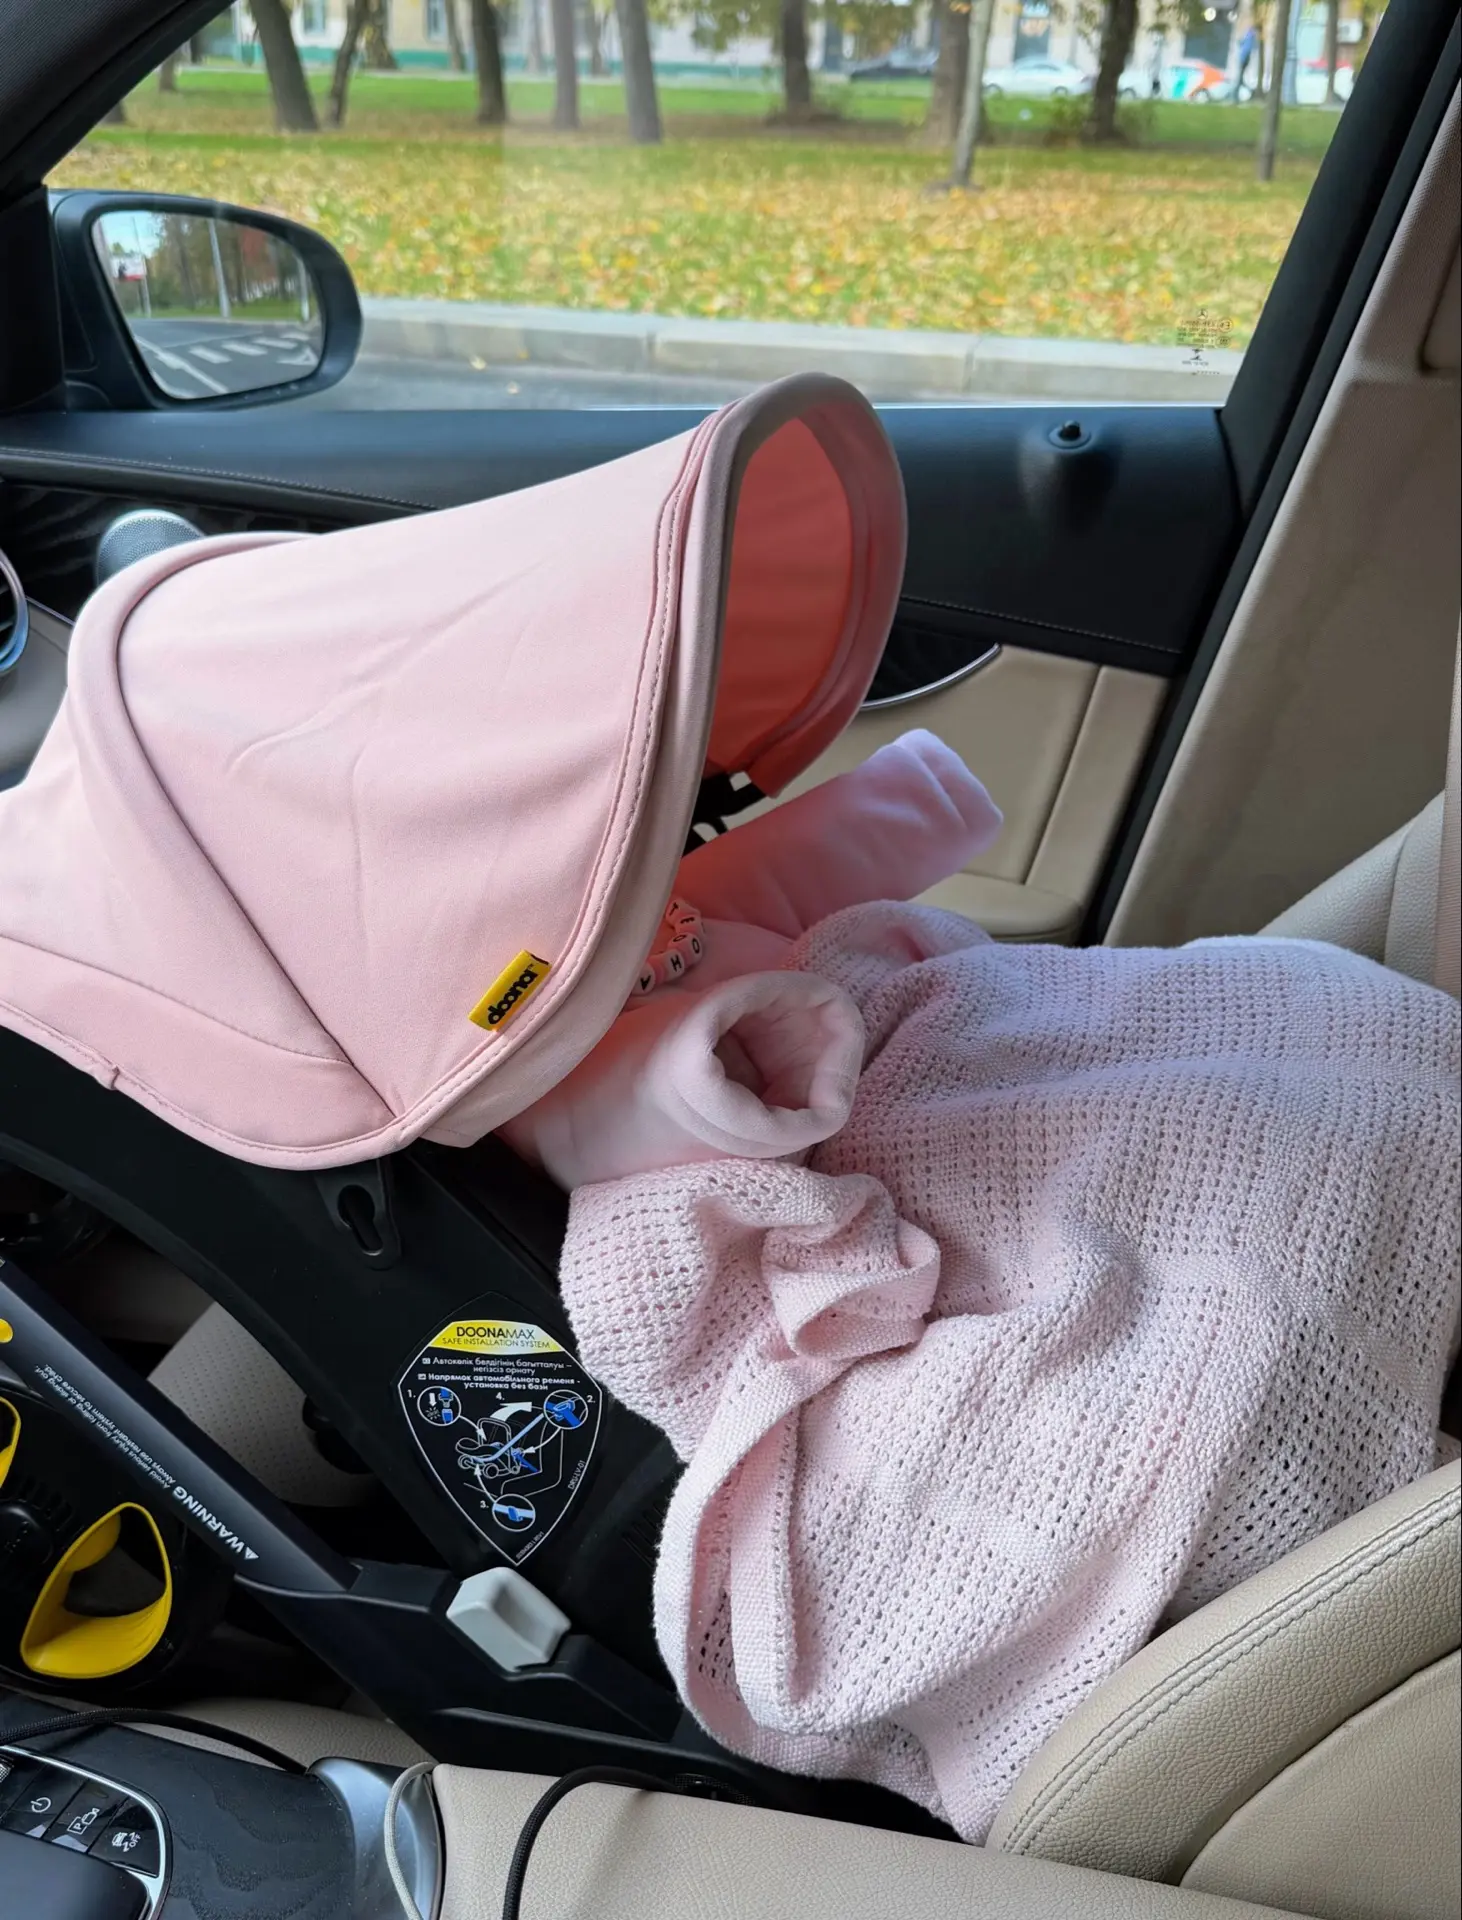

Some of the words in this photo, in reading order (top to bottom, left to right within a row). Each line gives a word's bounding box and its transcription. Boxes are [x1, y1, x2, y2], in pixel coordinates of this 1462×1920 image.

[456, 1326, 536, 1340] DOONAMAX
[442, 1337, 462, 1345] SAFE
[463, 1338, 519, 1347] INSTALLATION
[520, 1340, 550, 1348] SYSTEM
[428, 1373, 471, 1382] Напрямок
[511, 1382, 527, 1390] без
[62, 1381, 86, 1403] secure
[92, 1408, 116, 1430] system
[95, 1421, 113, 1438] from
[110, 1435, 130, 1453] injury
[114, 1428, 142, 1453] restraint
[128, 1450, 152, 1472] serious
[141, 1452, 153, 1464] use
[149, 1470, 171, 1489] Avoid
[151, 1461, 177, 1484] Always
[172, 1485, 246, 1553] WARNING
[129, 1834, 142, 1847] OFF
